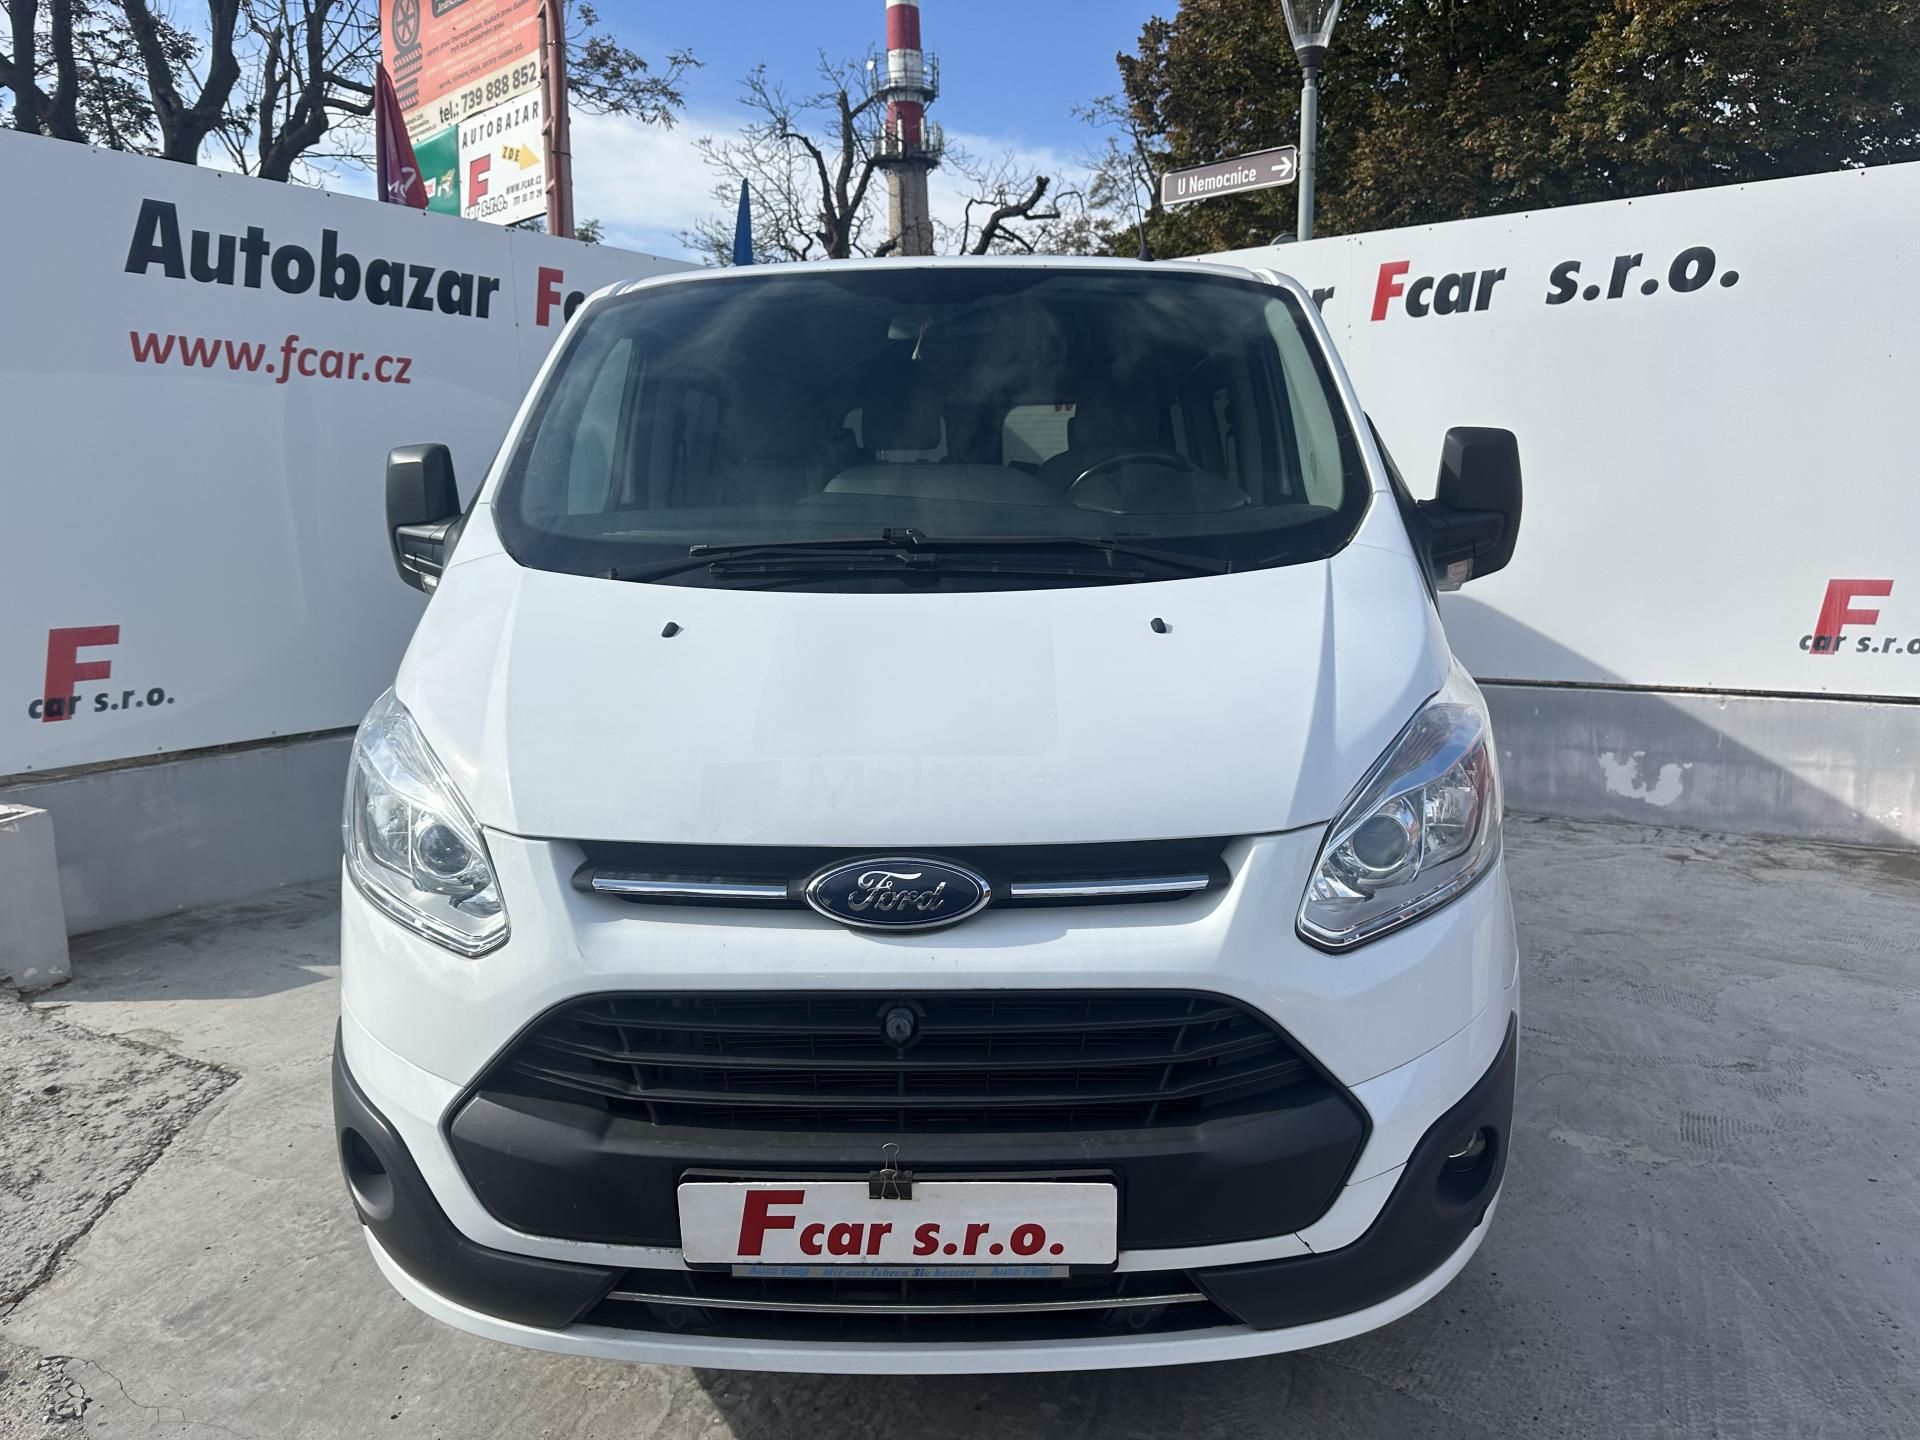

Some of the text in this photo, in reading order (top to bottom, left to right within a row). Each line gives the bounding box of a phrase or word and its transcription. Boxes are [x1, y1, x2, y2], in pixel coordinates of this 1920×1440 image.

[440, 101, 459, 124] tel.:
[461, 87, 483, 113] 739
[486, 75, 509, 102] 888
[512, 61, 537, 90] 852
[462, 100, 539, 149] AUTOBAZAR
[502, 146, 520, 162] ZDE
[1177, 166, 1257, 195] U Nemocnice
[124, 198, 585, 327] Autobazar Fc
[1370, 260, 1507, 321] Fcar
[1545, 246, 1739, 305] s.r.o.
[129, 331, 413, 385] www.fcar.cz
[1809, 579, 1894, 655] F
[1856, 636, 1920, 654] s.r.o
[42, 624, 120, 722] F
[94, 687, 175, 712] s.r.o.
[847, 869, 947, 912] Ford
[737, 1190, 1064, 1256] Fcar s.r.o.
[750, 1265, 777, 1276] Auto
[823, 1267, 838, 1277] Mit
[912, 1268, 930, 1277] Sie
[990, 1266, 1020, 1277] Auto
